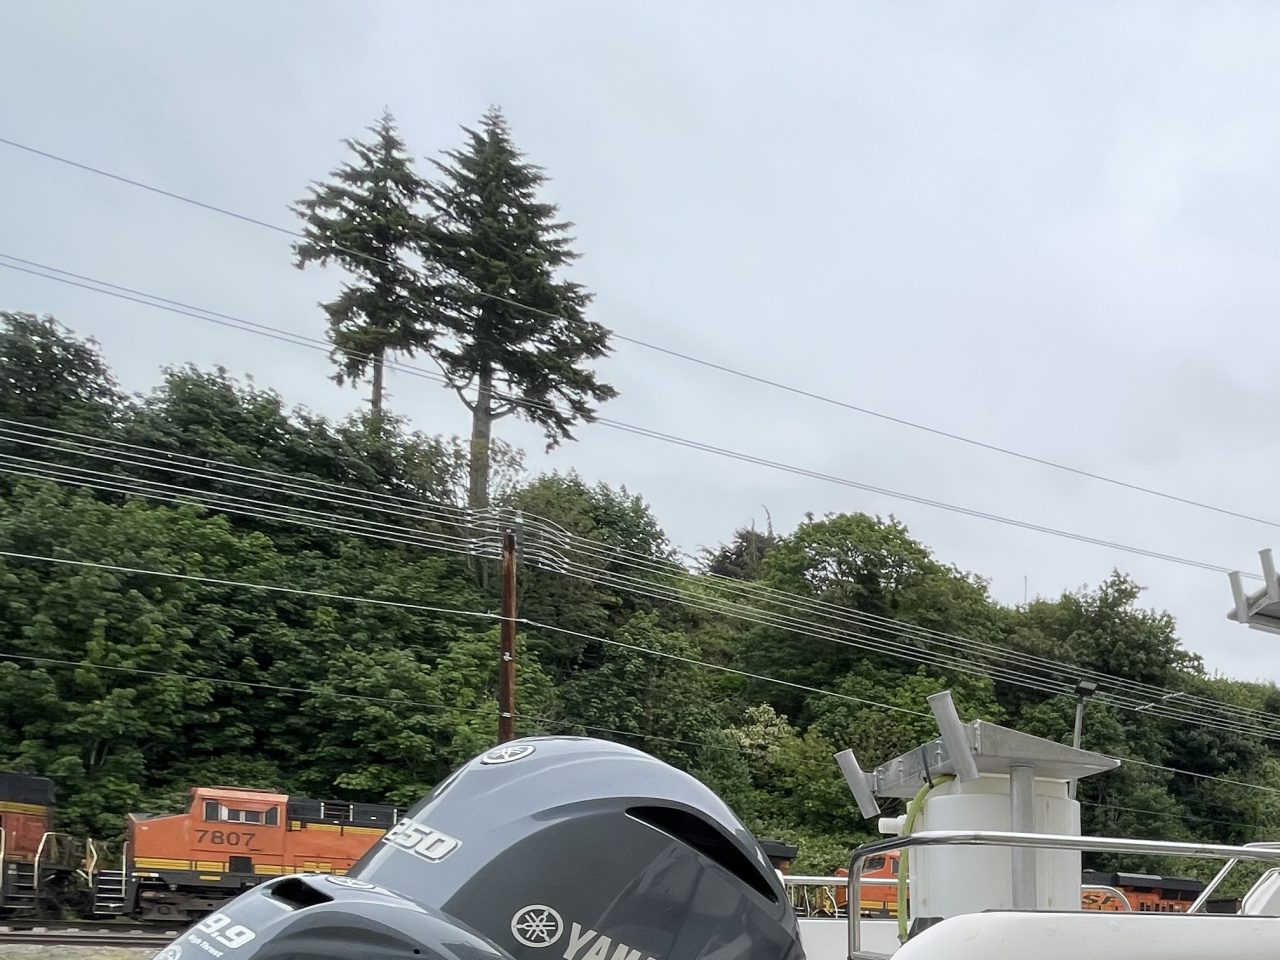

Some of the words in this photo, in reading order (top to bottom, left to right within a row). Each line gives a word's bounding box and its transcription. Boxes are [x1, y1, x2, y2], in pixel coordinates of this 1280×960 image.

[194, 829, 256, 846] 7807
[382, 818, 461, 862] 250
[197, 913, 256, 949] 9.9
